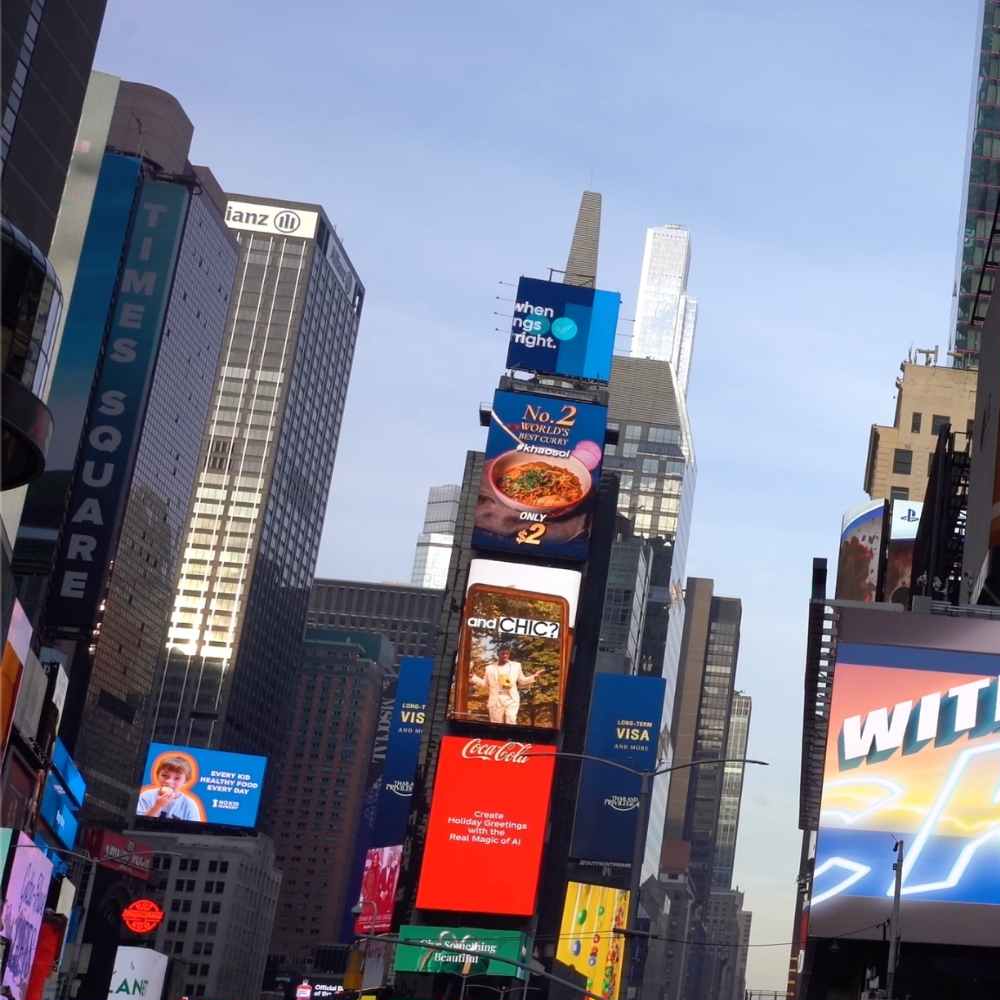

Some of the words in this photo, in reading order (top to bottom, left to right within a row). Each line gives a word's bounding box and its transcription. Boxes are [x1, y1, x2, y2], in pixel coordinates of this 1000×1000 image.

[111, 202, 168, 364] TIMES
[514, 301, 554, 318] when
[514, 332, 557, 350] right.
[520, 422, 570, 437] WORLD'S
[518, 433, 539, 443] BEST
[540, 435, 569, 446] CURRY
[59, 391, 126, 599] SQUARE
[519, 512, 547, 523] ONLY
[516, 523, 548, 545] $2
[468, 617, 498, 630] and
[500, 617, 560, 638] CHIC?
[616, 727, 650, 742] VISA
[474, 811, 504, 819] Create
[448, 817, 481, 827] Holiday
[484, 820, 528, 831] Greetings
[449, 833, 469, 841] Real
[471, 836, 498, 845] Magic
[490, 828, 505, 837] the
